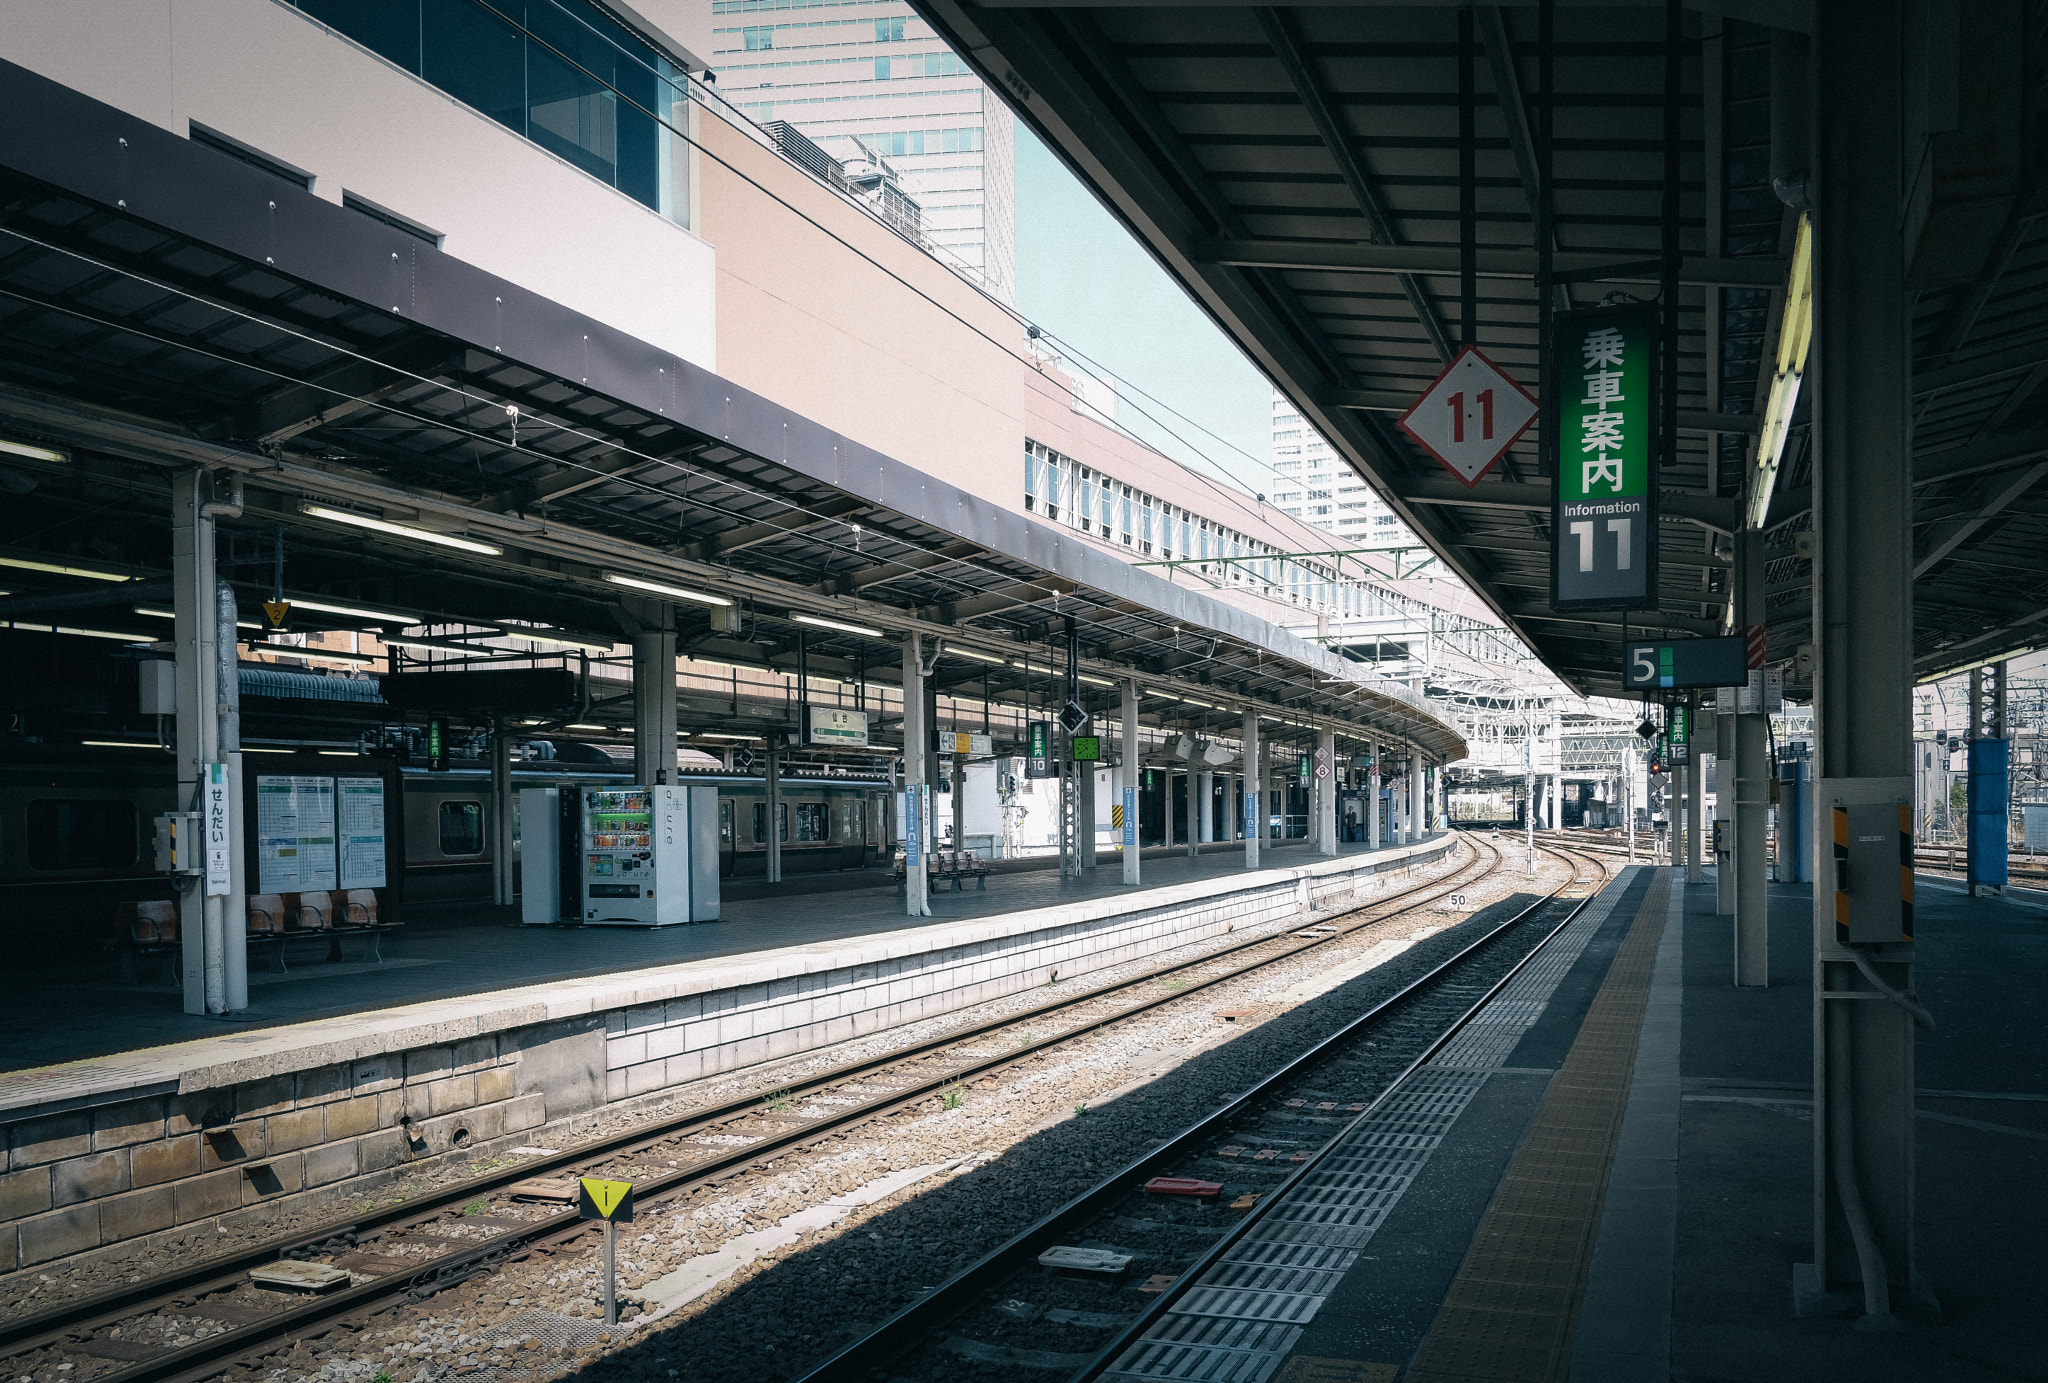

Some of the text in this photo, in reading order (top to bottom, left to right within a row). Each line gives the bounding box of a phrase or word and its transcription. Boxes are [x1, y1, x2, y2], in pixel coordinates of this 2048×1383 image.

[1447, 388, 1494, 443] 11
[1581, 327, 1625, 494] 乗車案内
[1564, 501, 1641, 517] Information
[1570, 518, 1631, 572] 11
[273, 609, 281, 621] 2
[1633, 647, 1655, 682] 5
[1673, 706, 1685, 742] 乗車案内
[1034, 724, 1042, 757] 乗車案内
[1670, 746, 1687, 759] 12
[432, 759, 438, 769] 4
[1032, 760, 1045, 771] 10
[1369, 757, 1375, 765] 4
[1319, 767, 1326, 776] 8
[211, 788, 224, 843] せんだい
[1451, 895, 1466, 905] 50
